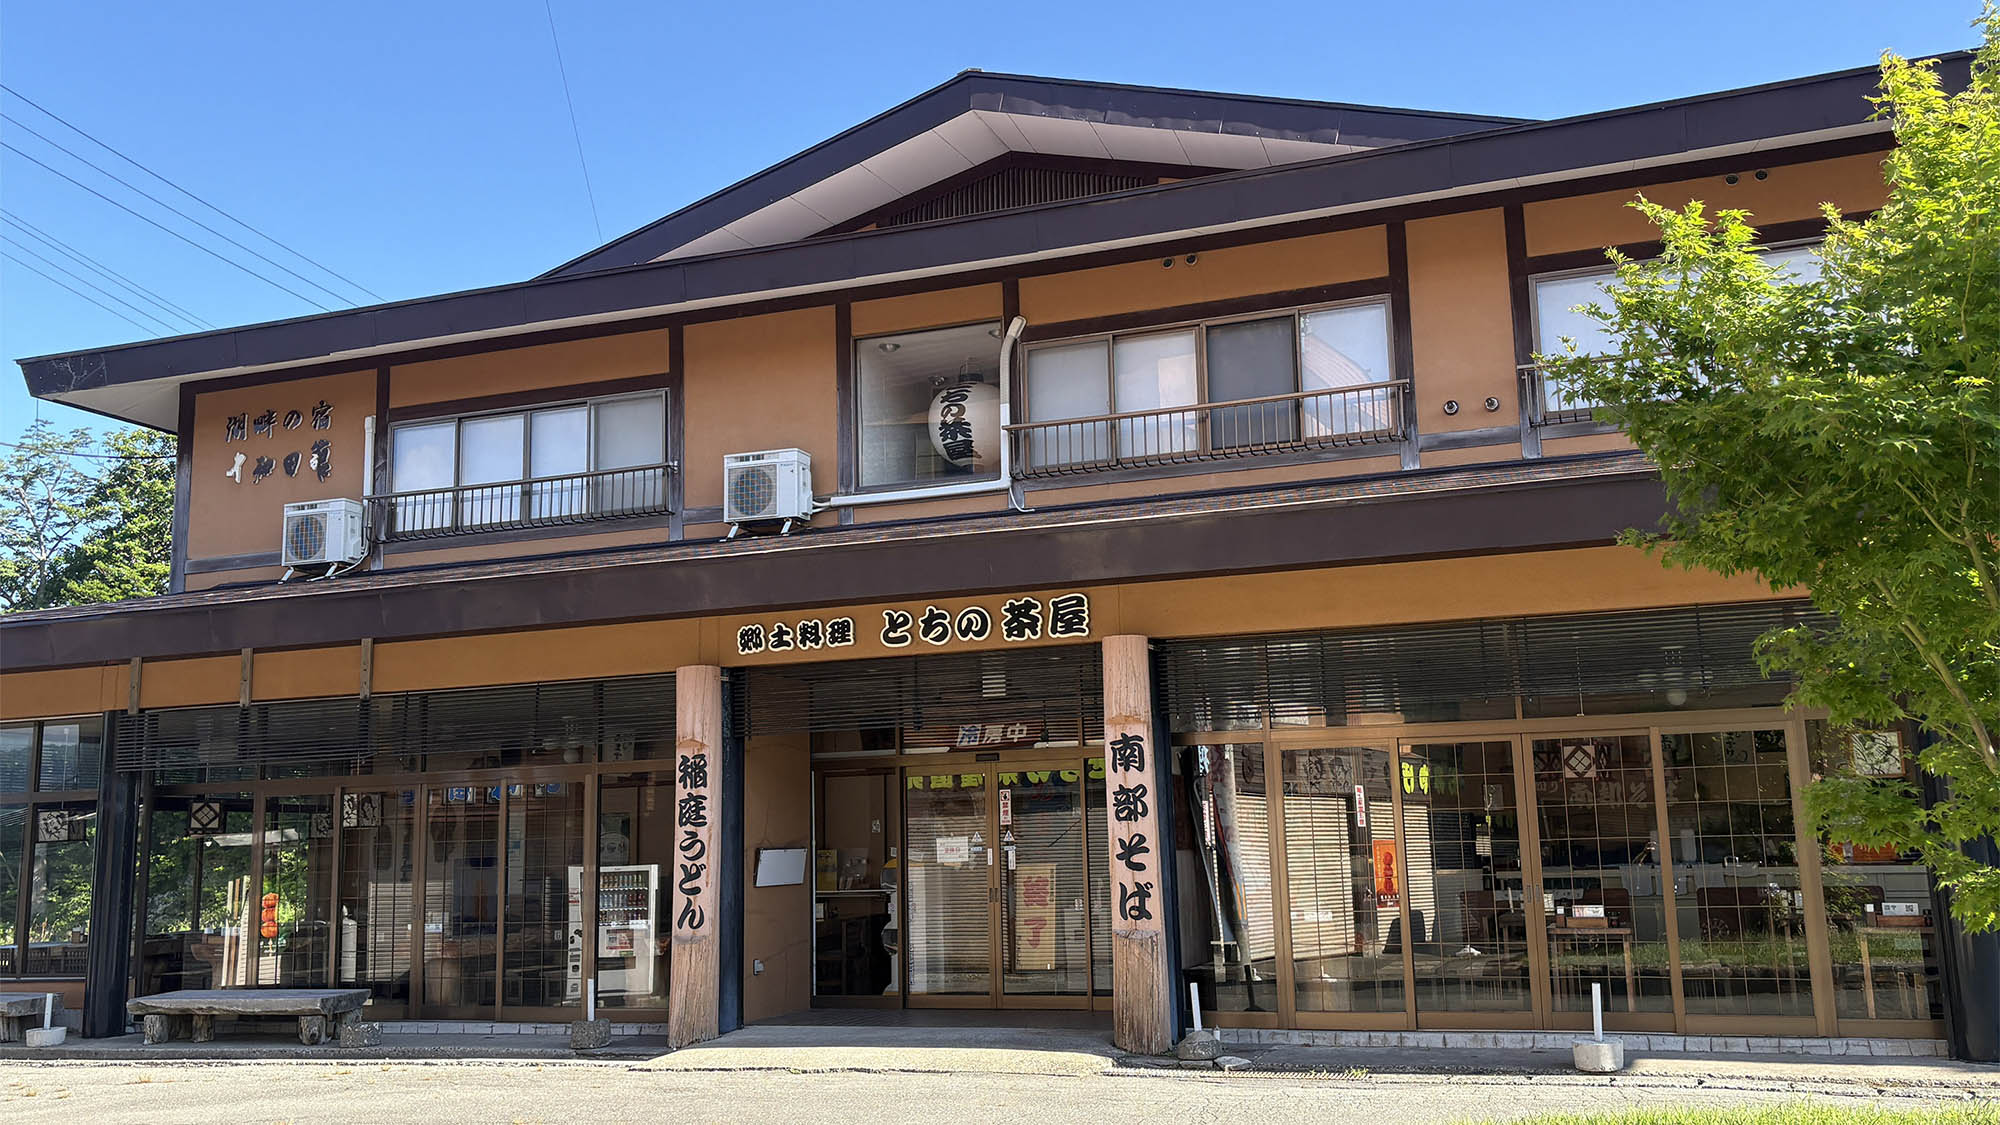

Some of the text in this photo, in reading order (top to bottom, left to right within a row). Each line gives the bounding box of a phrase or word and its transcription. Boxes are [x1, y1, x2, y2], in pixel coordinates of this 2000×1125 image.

[225, 400, 334, 443] 湖畔の宿
[738, 593, 1090, 654] 郷土料理 とちの茶屋
[957, 723, 1027, 746] 冷房中
[678, 753, 707, 929] 稲庭うどん
[1109, 733, 1153, 920] 南部そば
